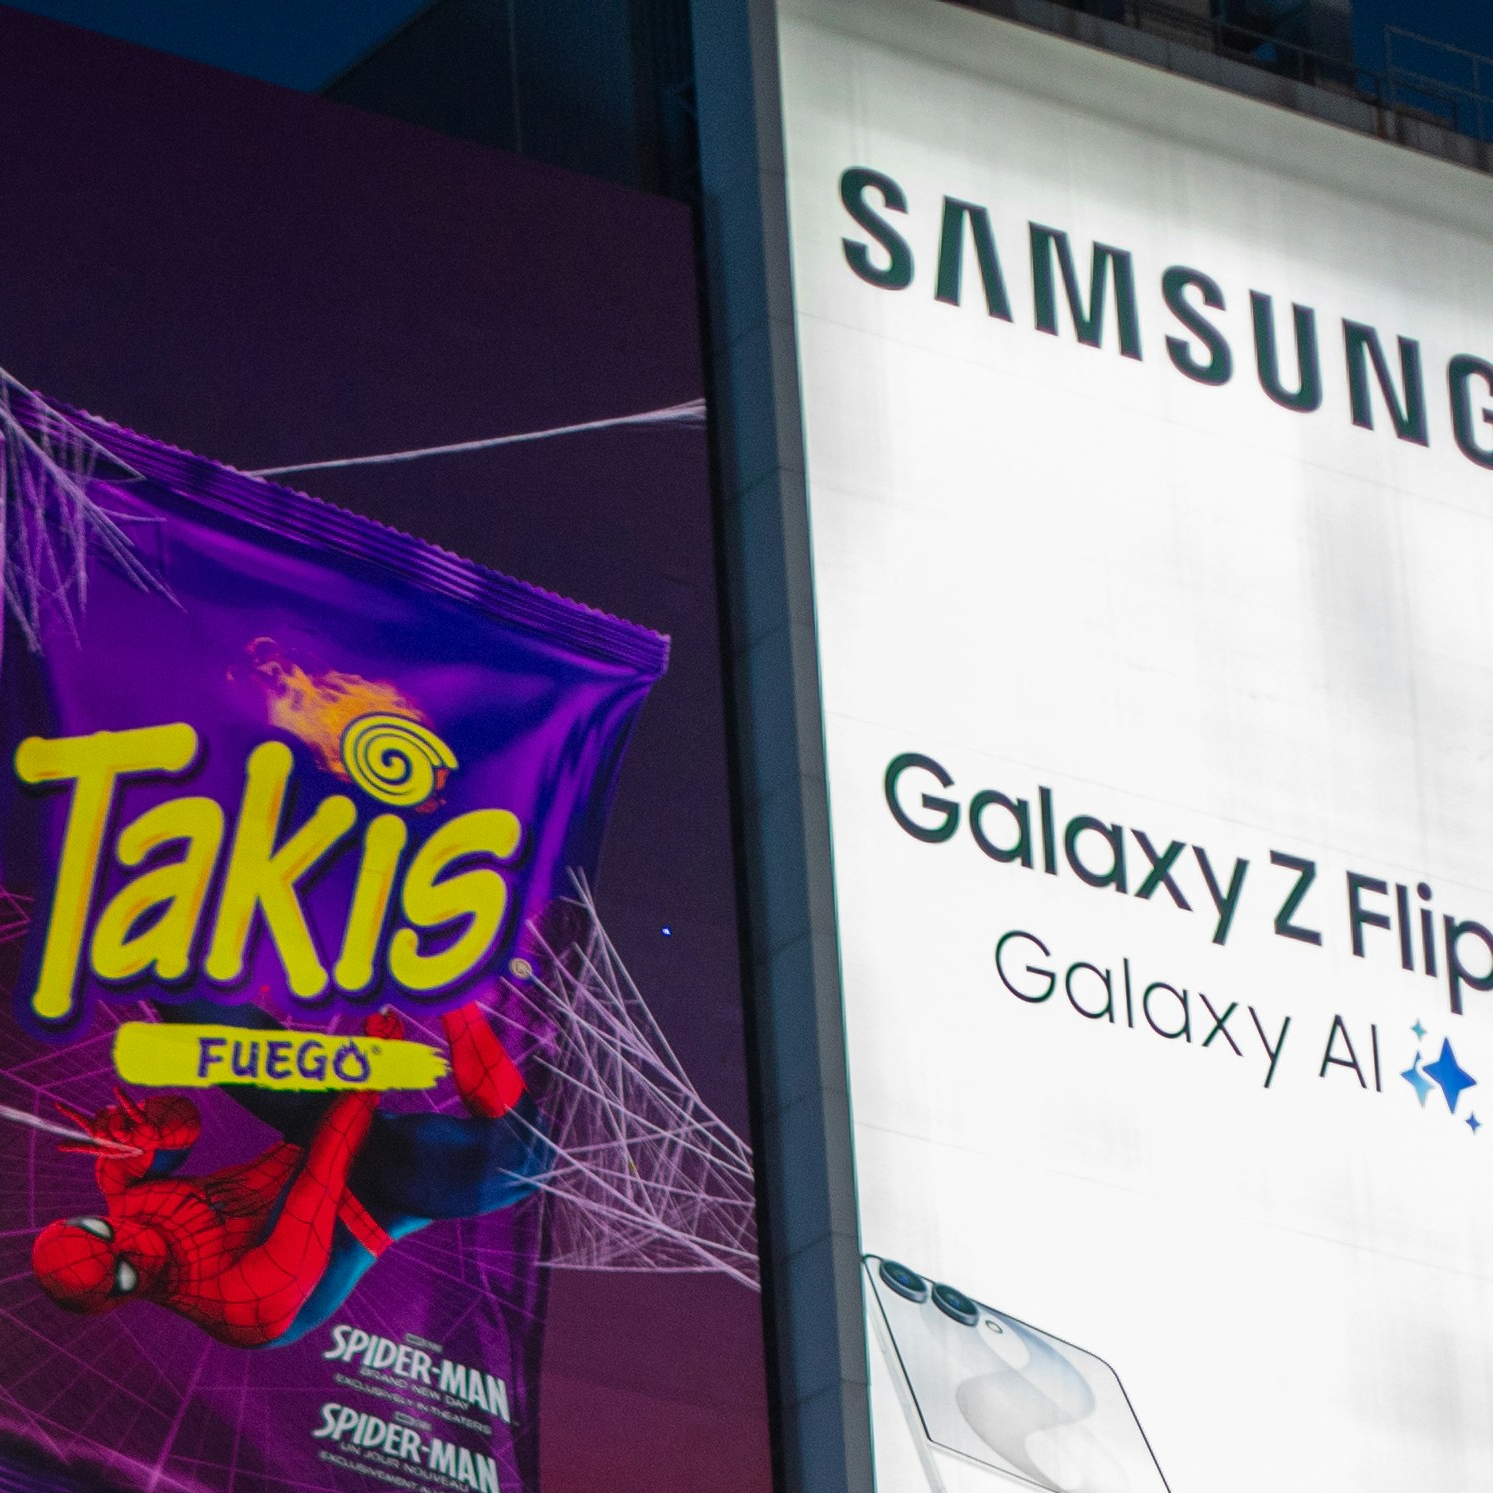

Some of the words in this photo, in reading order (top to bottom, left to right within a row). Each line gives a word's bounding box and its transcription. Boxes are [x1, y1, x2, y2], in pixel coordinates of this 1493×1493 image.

[15, 712, 522, 1018] Takis
[883, 751, 1249, 946] Galaxy
[1269, 849, 1323, 947] Z
[197, 1034, 372, 1083] FUEGO
[994, 929, 1291, 1088] Galaxy
[1319, 1012, 1384, 1094] AI
[323, 1324, 511, 1425] SPIDER-MAN
